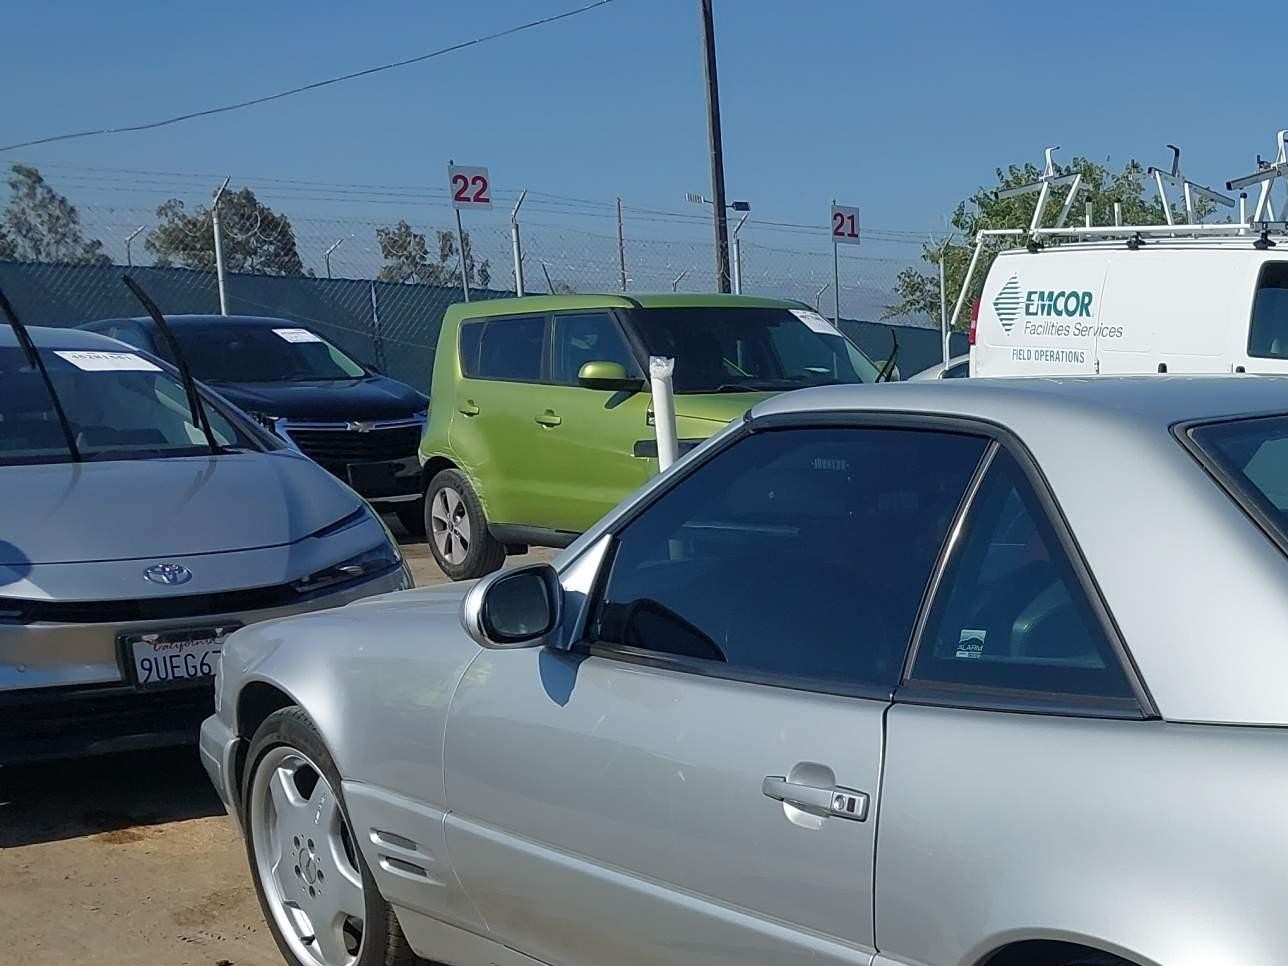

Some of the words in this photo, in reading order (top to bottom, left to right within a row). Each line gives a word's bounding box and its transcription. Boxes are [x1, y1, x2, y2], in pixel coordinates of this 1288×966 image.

[452, 174, 490, 203] 22
[833, 212, 859, 238] 21
[1024, 290, 1093, 317] EMCOR
[1024, 320, 1070, 337] Facilities
[1073, 322, 1123, 338] Services
[1012, 348, 1032, 361] FIELD
[1034, 350, 1085, 363] OPERATIONS
